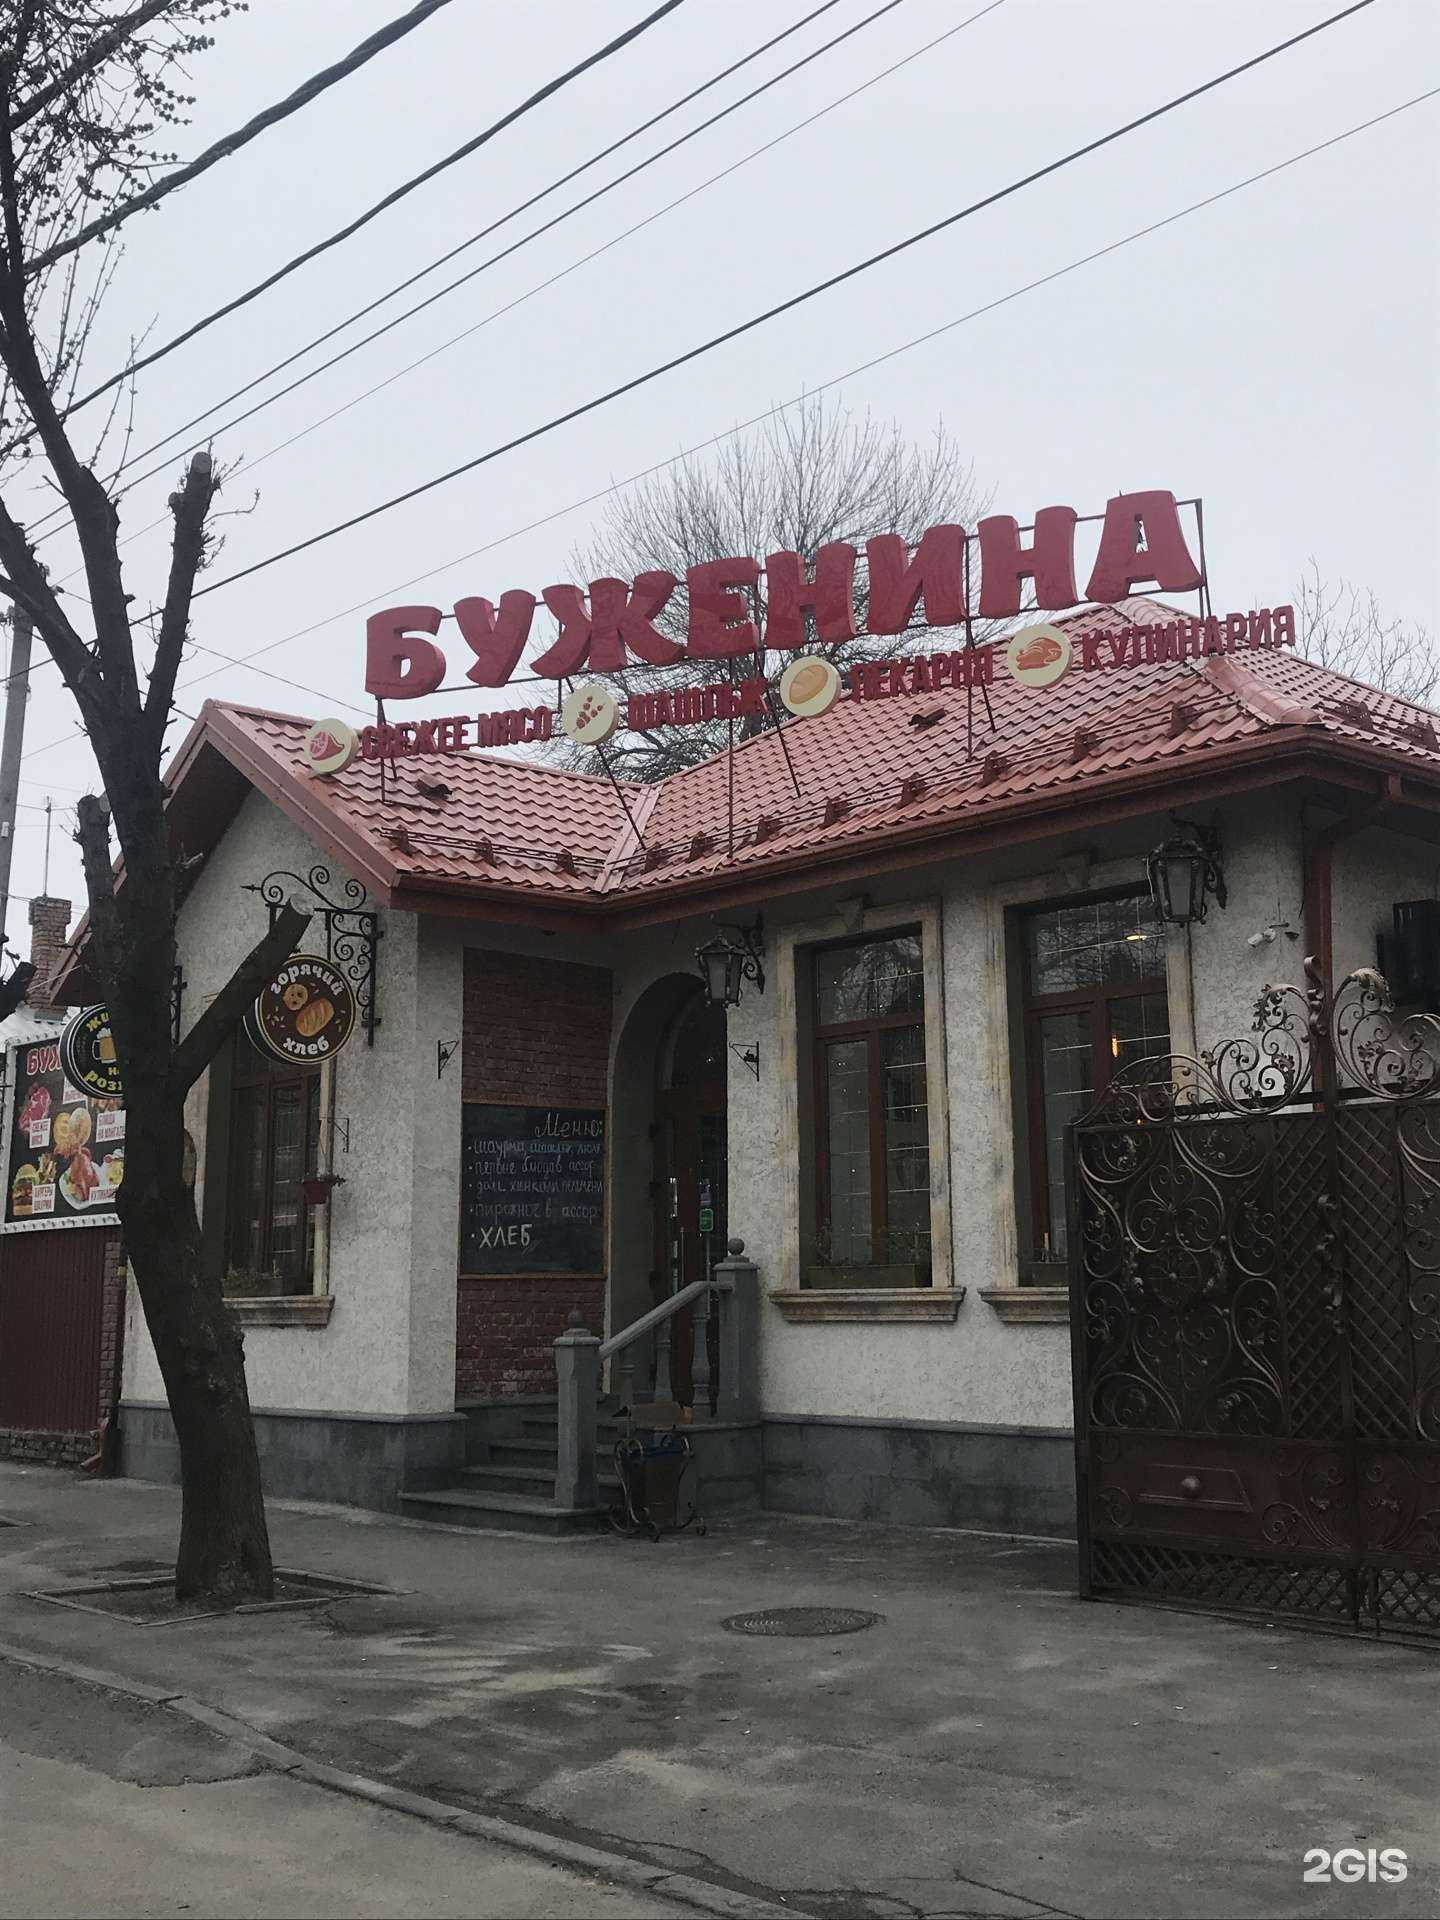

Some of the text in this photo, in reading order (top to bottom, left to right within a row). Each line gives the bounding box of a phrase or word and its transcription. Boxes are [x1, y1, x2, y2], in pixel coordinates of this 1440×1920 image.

[365, 490, 1205, 699] БУЖЕНИНА
[1082, 605, 1295, 673] КУЛИНАРИЯ
[850, 646, 993, 704] ПЕКАРНЯ
[627, 677, 769, 732] ШАШЛЫК
[361, 706, 552, 760] СВЕЖЕЕ МЯСО
[479, 1224, 533, 1248] ХЛЕБ
